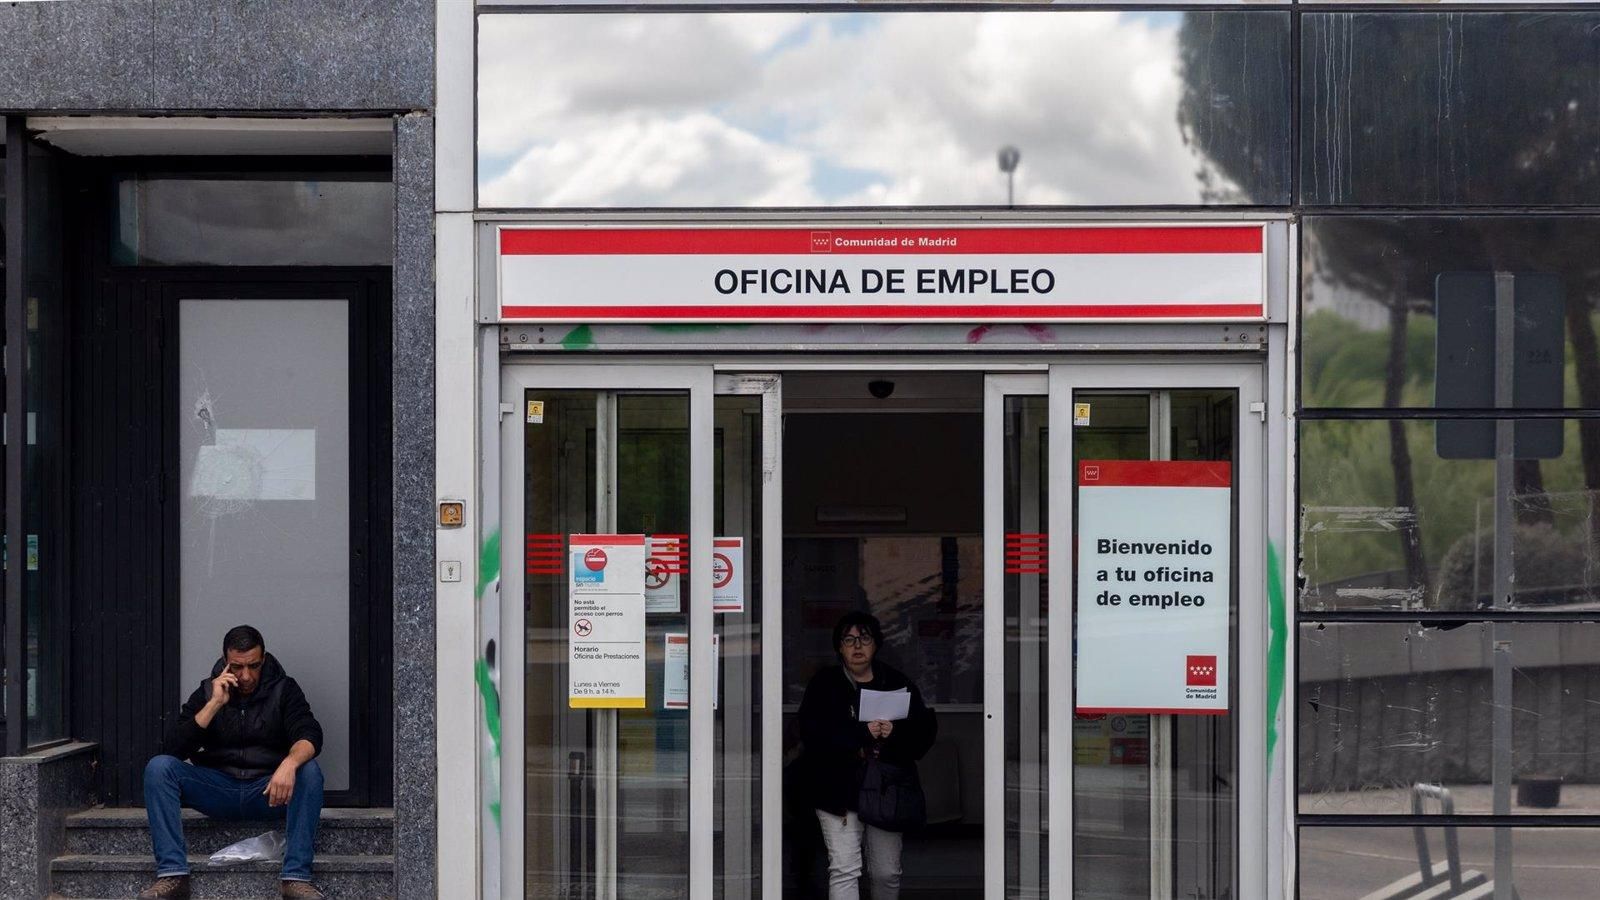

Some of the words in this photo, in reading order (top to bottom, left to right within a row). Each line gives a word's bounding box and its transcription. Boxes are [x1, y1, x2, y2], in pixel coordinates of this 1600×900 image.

[834, 237, 898, 247] Comunidad
[900, 237, 915, 247] de
[918, 237, 957, 247] Madrid
[714, 268, 851, 295] OFICINA
[861, 269, 906, 294] DE
[916, 268, 1056, 295] EMPLEO
[1097, 538, 1213, 556] Bienvenido
[1096, 569, 1108, 582] a
[1115, 566, 1136, 582] tu
[1143, 566, 1214, 583] oficina
[1096, 590, 1122, 606] de
[1128, 590, 1205, 610] empleo
